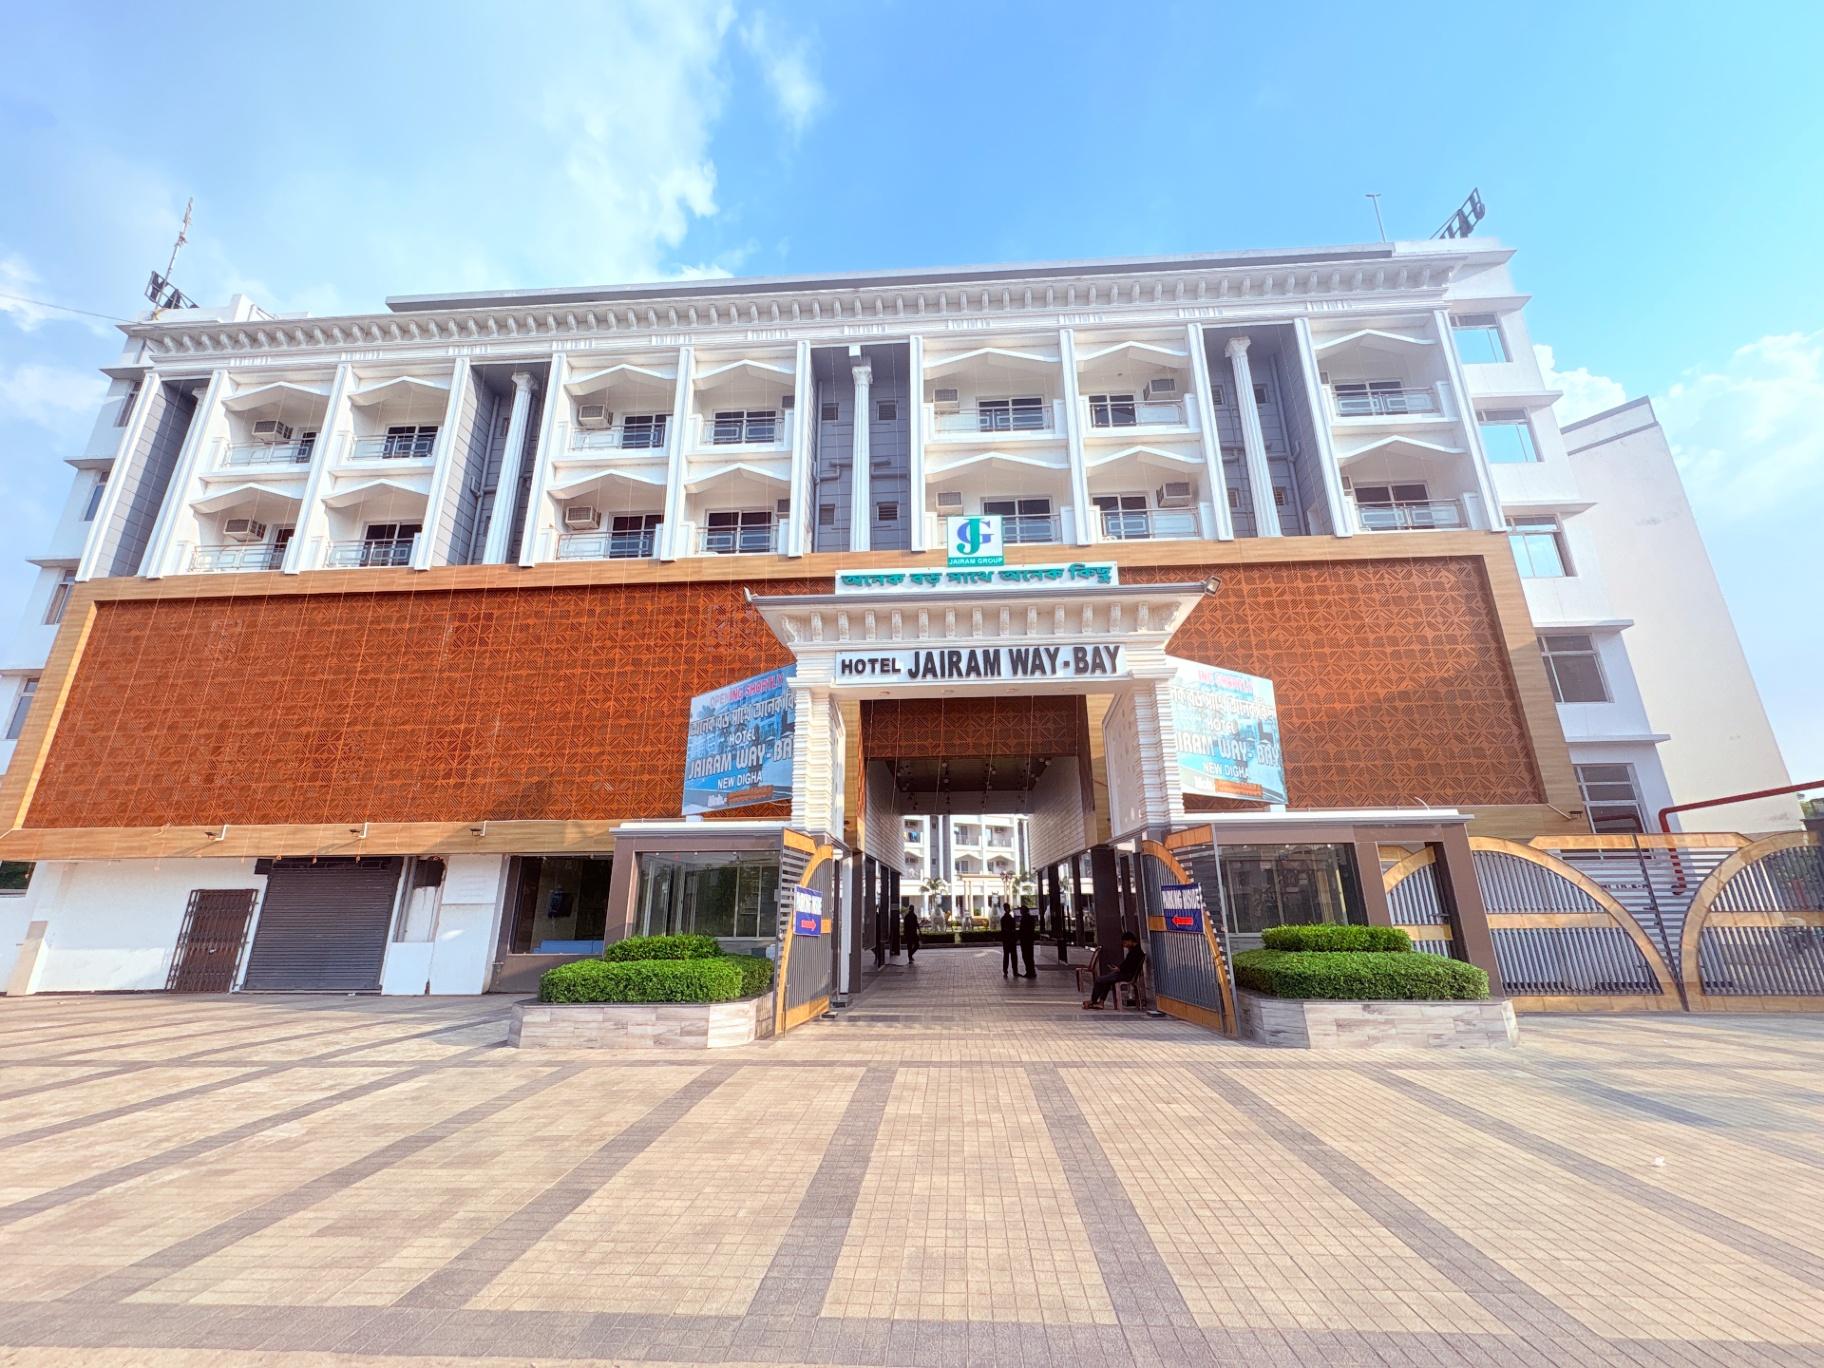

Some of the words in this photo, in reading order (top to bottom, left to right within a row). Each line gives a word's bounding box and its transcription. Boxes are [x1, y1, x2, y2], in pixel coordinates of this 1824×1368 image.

[949, 558, 976, 566] JAIRAM
[977, 557, 1003, 565] GROUP
[841, 573, 906, 587] অনেক
[998, 568, 1065, 582] অনেক
[841, 657, 902, 675] HOTEL
[908, 648, 1002, 679] JAIRAM
[1207, 718, 1239, 734] HOTEL
[729, 729, 756, 746] HOTEL
[1175, 730, 1216, 757] IRAM
[689, 752, 732, 780] JAIRAM
[736, 737, 794, 770] WAY-BA
[718, 776, 735, 790] NEW
[737, 770, 763, 787] DIGHA
[1205, 762, 1223, 776] NEW
[1224, 764, 1250, 780] DIGHA
